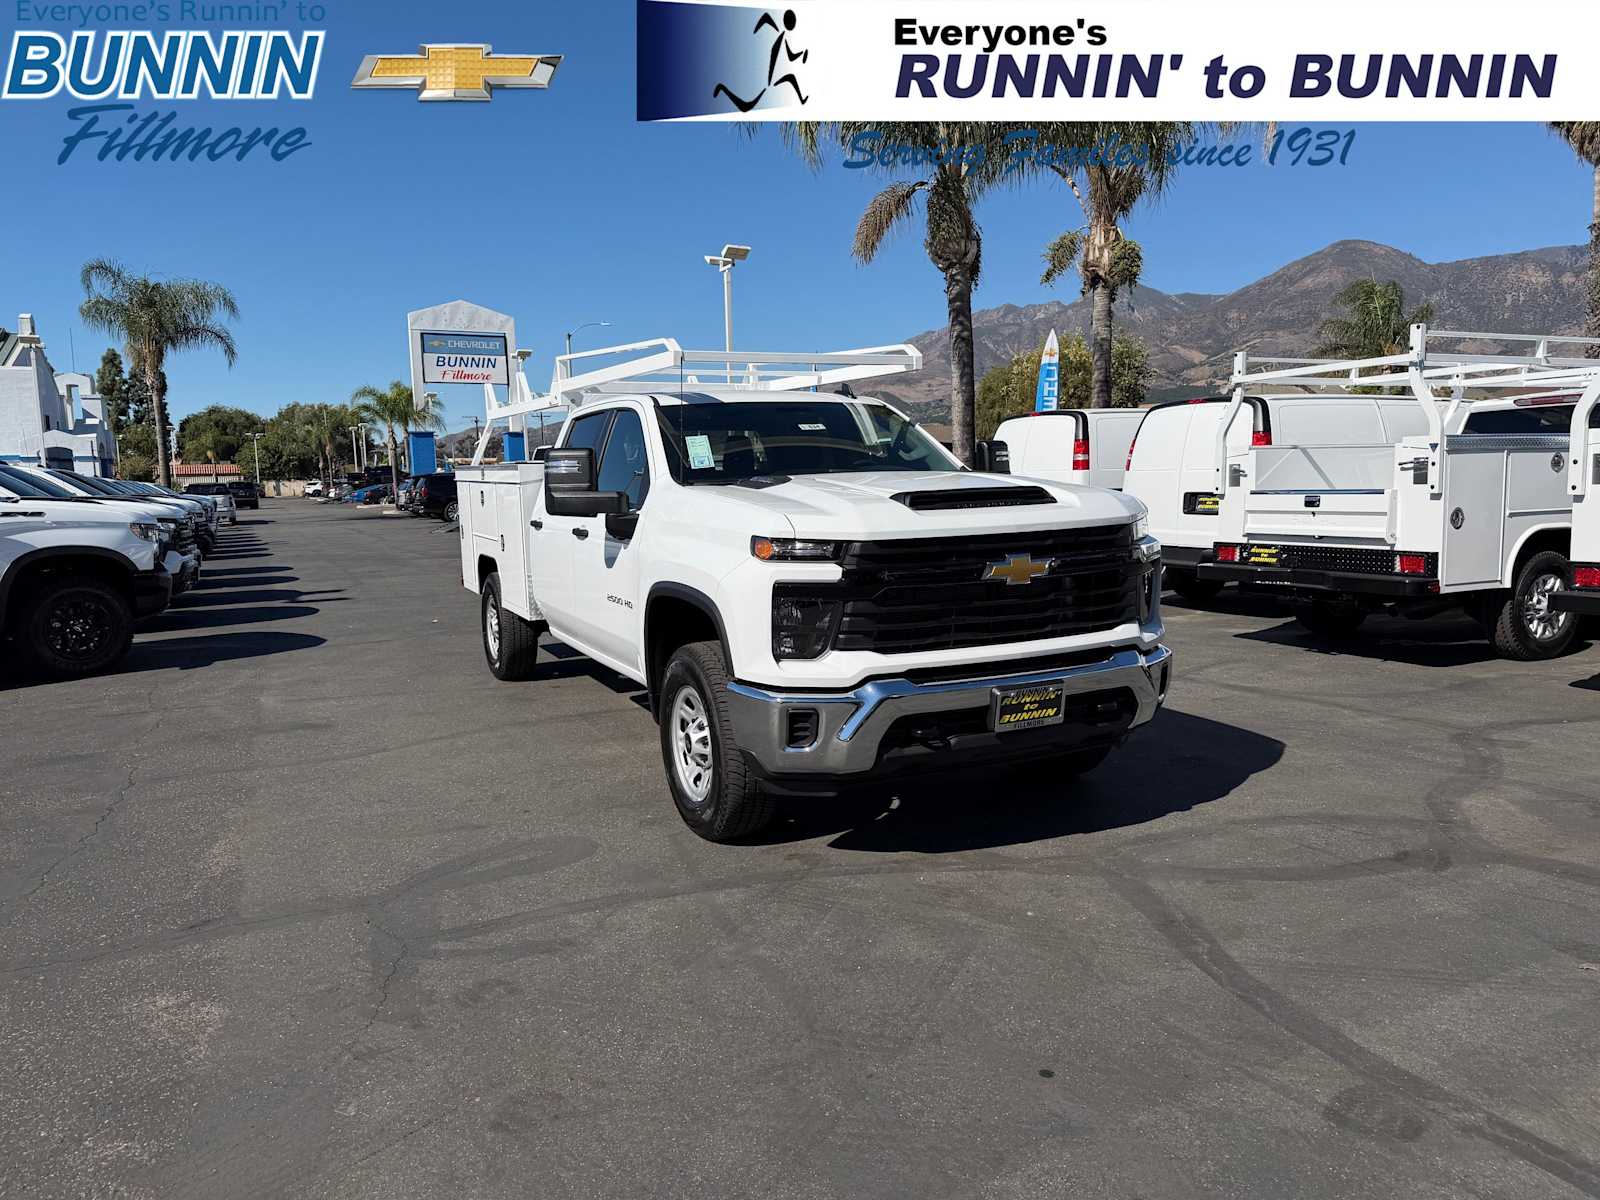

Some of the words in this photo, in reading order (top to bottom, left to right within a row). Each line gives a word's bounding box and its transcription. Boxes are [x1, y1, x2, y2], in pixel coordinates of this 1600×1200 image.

[447, 340, 500, 350] CHEVROLET
[436, 355, 497, 369] BUNNIN
[440, 369, 492, 381] Fillmore
[1024, 703, 1039, 711] to
[999, 707, 1058, 724] BUNNIN
